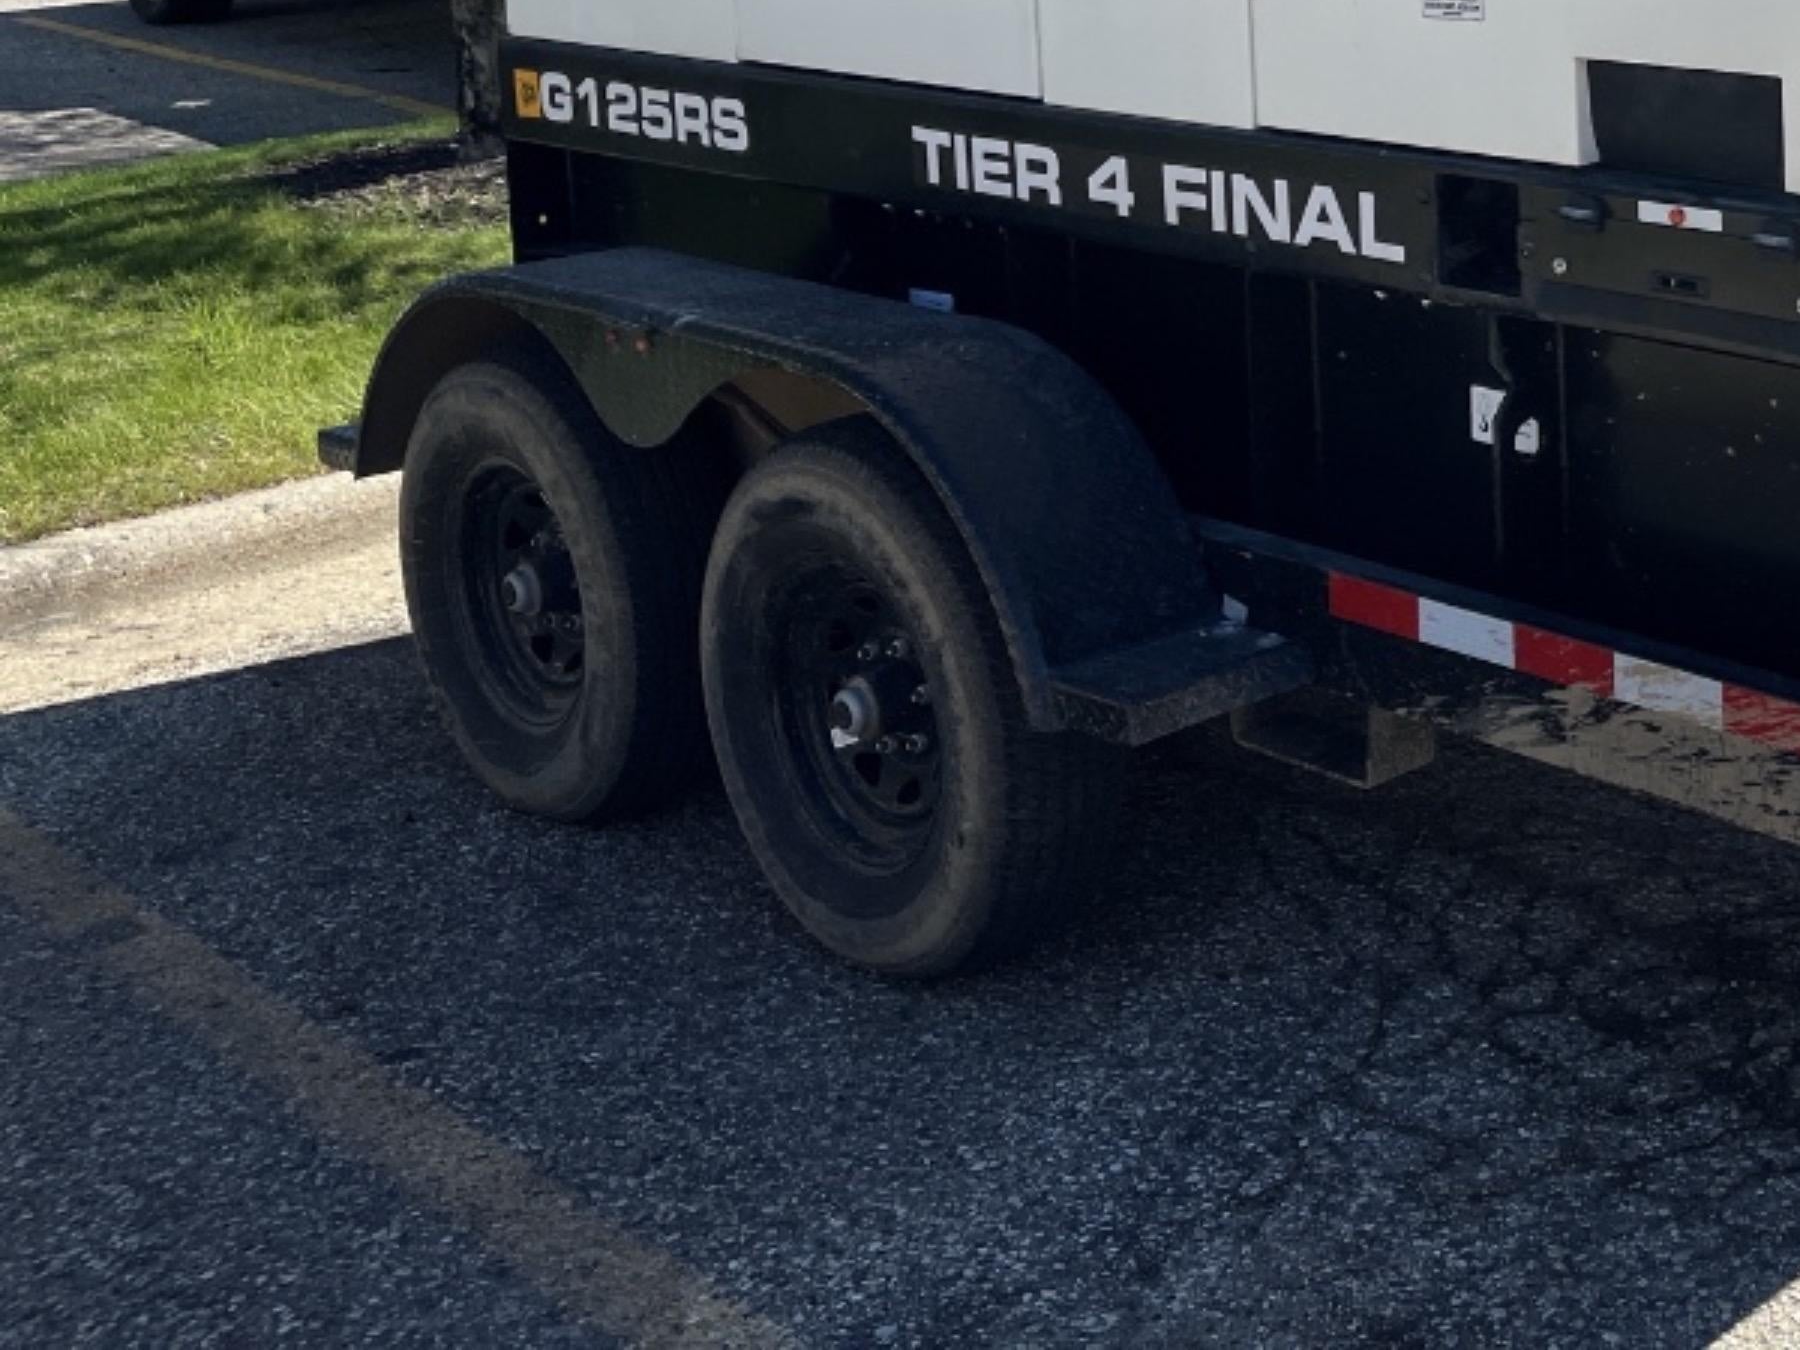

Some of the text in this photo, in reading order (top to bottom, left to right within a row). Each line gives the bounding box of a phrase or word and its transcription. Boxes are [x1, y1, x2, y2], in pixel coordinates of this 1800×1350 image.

[540, 72, 748, 151] G125RS
[912, 125, 1405, 263] TIER 4 FINAL
